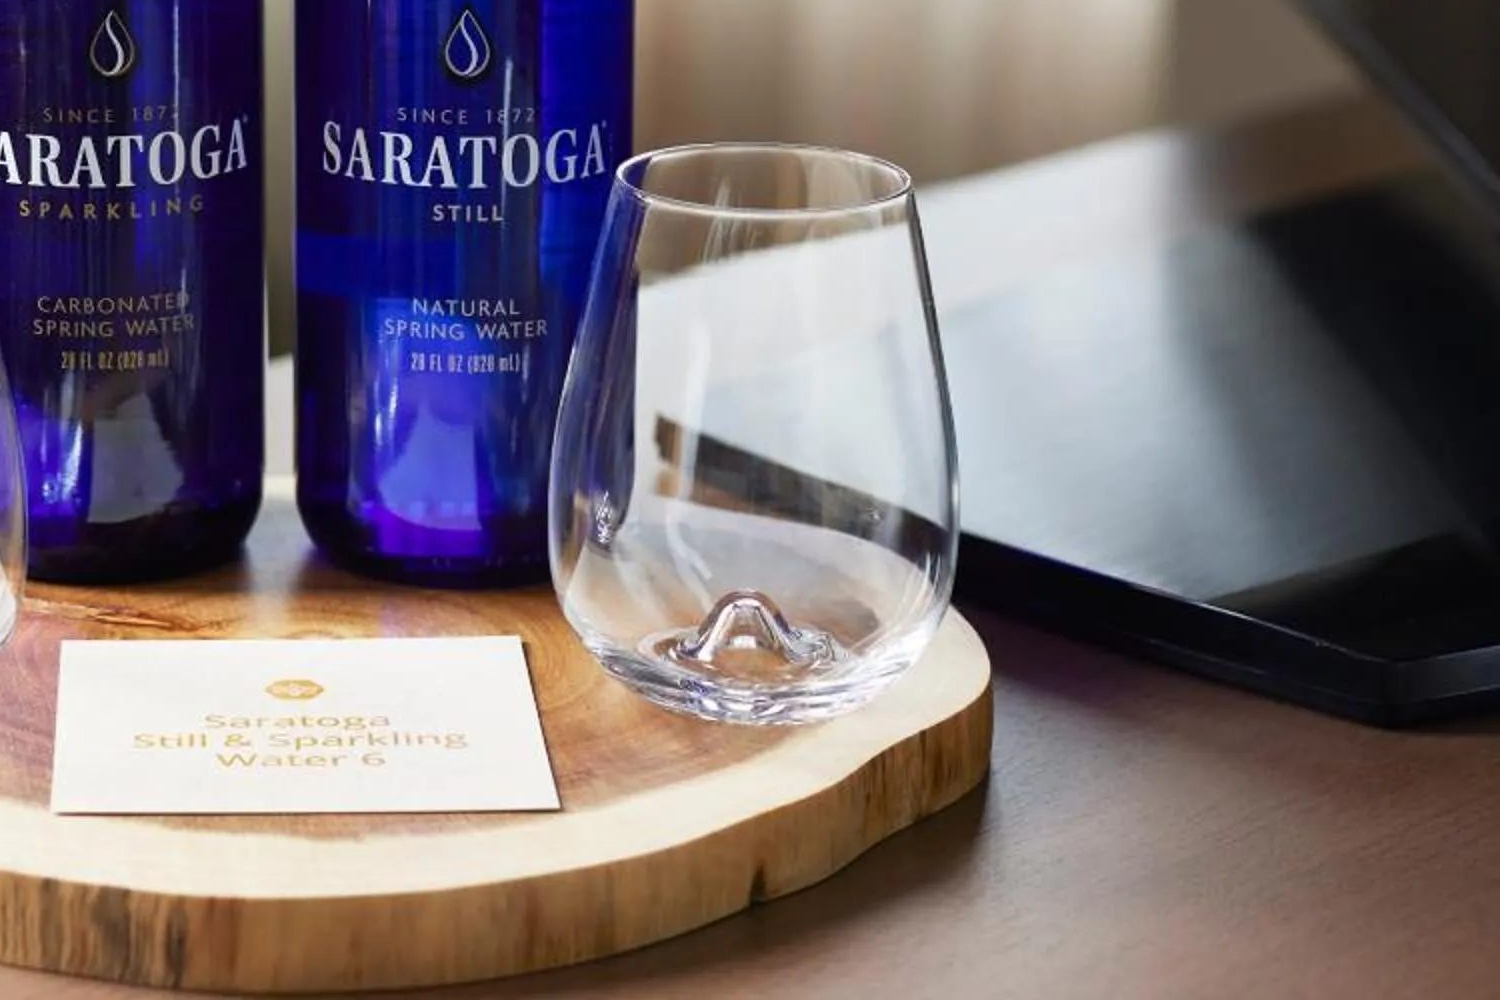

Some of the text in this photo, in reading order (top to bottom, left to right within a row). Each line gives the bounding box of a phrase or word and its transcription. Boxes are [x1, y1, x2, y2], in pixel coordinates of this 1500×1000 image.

[43, 107, 116, 124] SINCE
[397, 107, 536, 125] SINCE 1872
[322, 121, 605, 189] SARATOGA
[19, 194, 203, 220] SPARKLING
[431, 204, 504, 222] STILL
[36, 292, 190, 315] CARBONATED
[411, 299, 521, 317] NATURAL
[32, 314, 195, 338] SPRING WATER
[383, 318, 548, 340] SPRING WATER
[429, 353, 443, 371] FL
[205, 714, 390, 730] Saratoga
[134, 731, 469, 750] Still & Sparkling
[217, 752, 386, 768] Water 6
